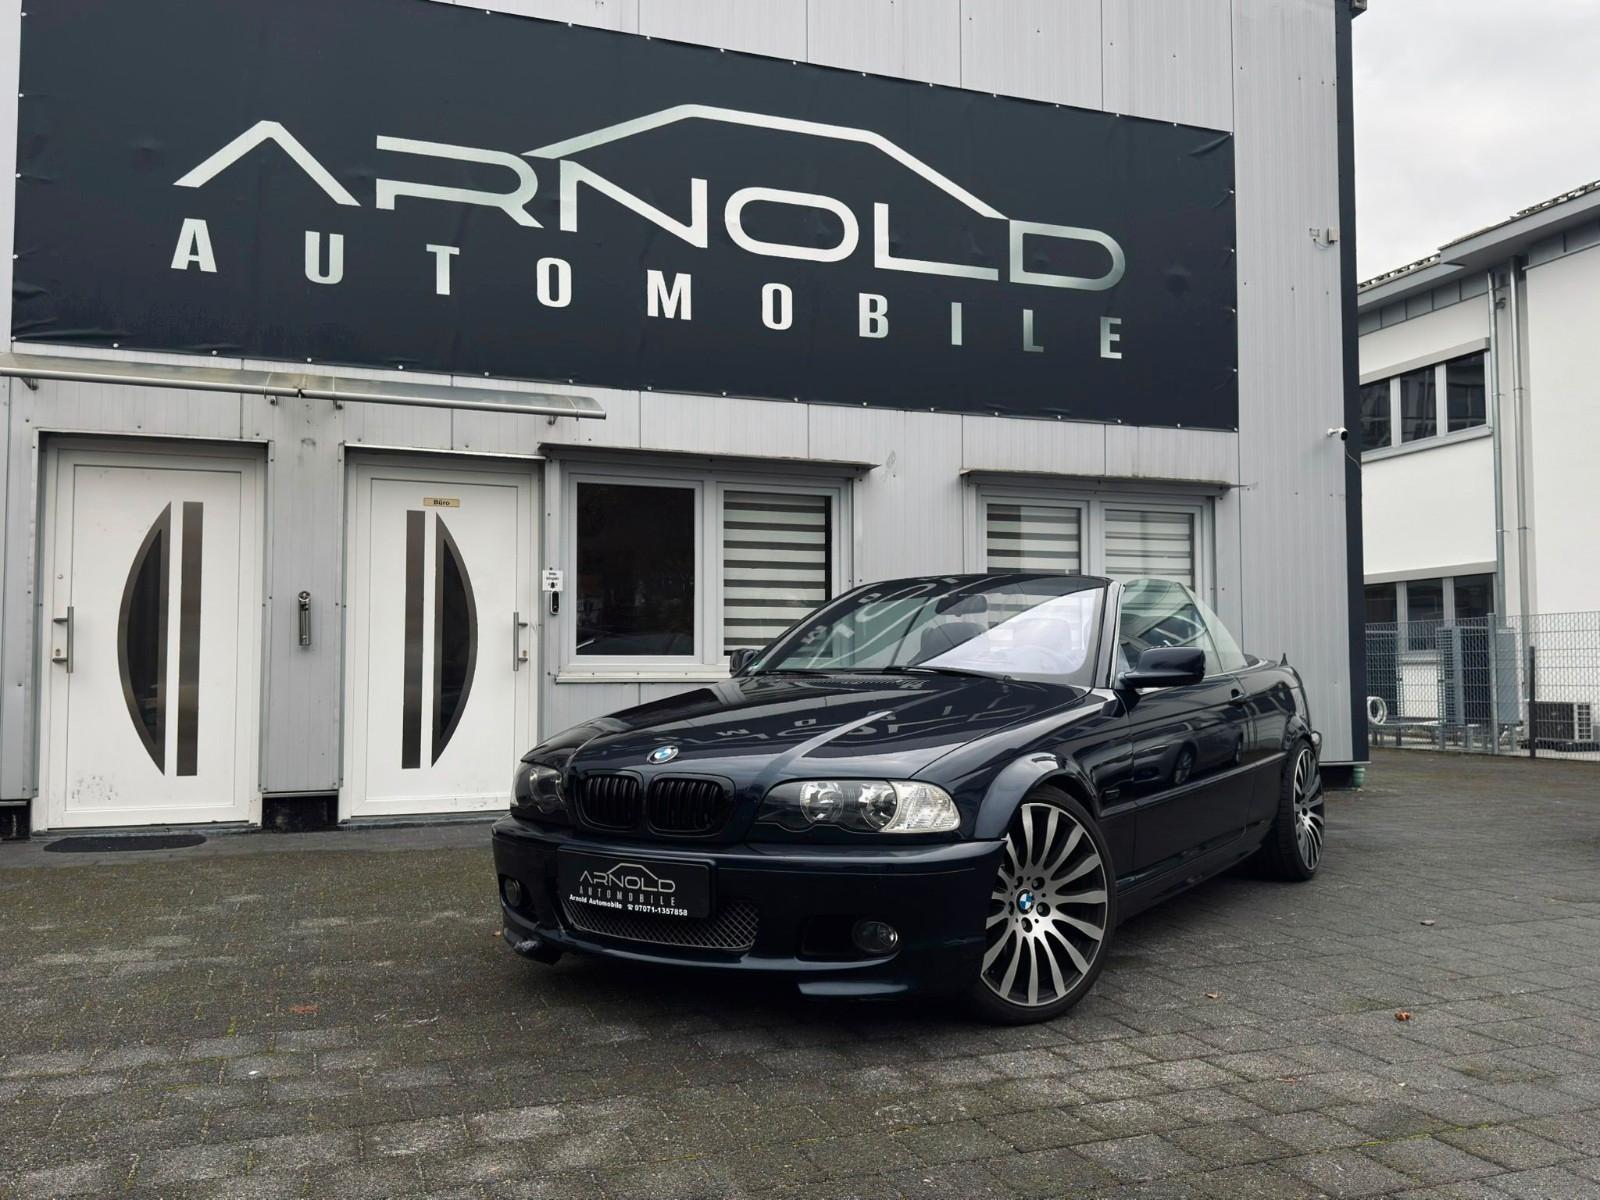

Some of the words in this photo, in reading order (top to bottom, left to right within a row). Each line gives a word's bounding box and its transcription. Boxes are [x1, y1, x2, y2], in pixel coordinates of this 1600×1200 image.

[173, 113, 1126, 291] ARNOLD
[170, 217, 1123, 360] AUTOMOBILE
[579, 866, 676, 893] ARNOLD
[569, 893, 588, 903] Arnold
[588, 897, 623, 909] Automobile
[579, 885, 676, 906] AUTOMOBILE
